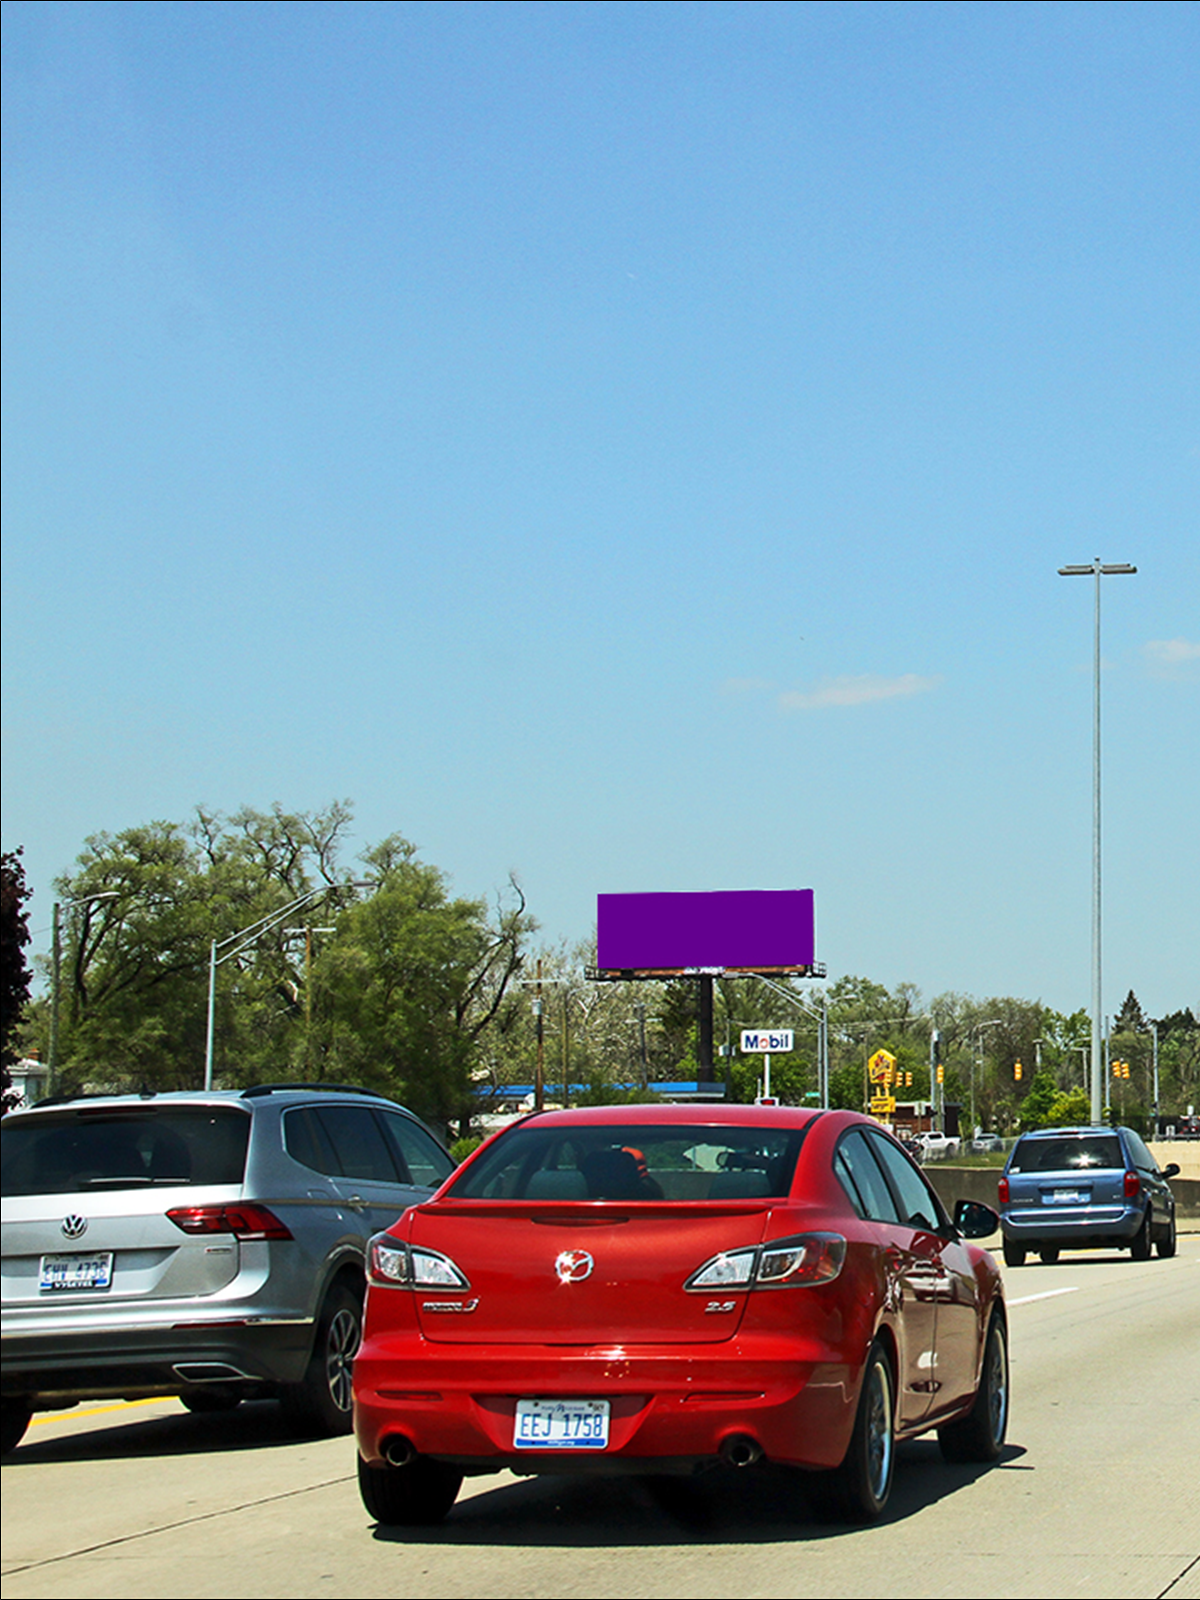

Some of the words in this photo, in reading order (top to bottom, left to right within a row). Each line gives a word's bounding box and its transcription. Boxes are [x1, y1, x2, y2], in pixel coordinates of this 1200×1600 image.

[745, 1034, 789, 1049] Mobil
[705, 1301, 737, 1313] 2.5
[520, 1413, 552, 1437] EEJ
[562, 1413, 604, 1437] 1758
